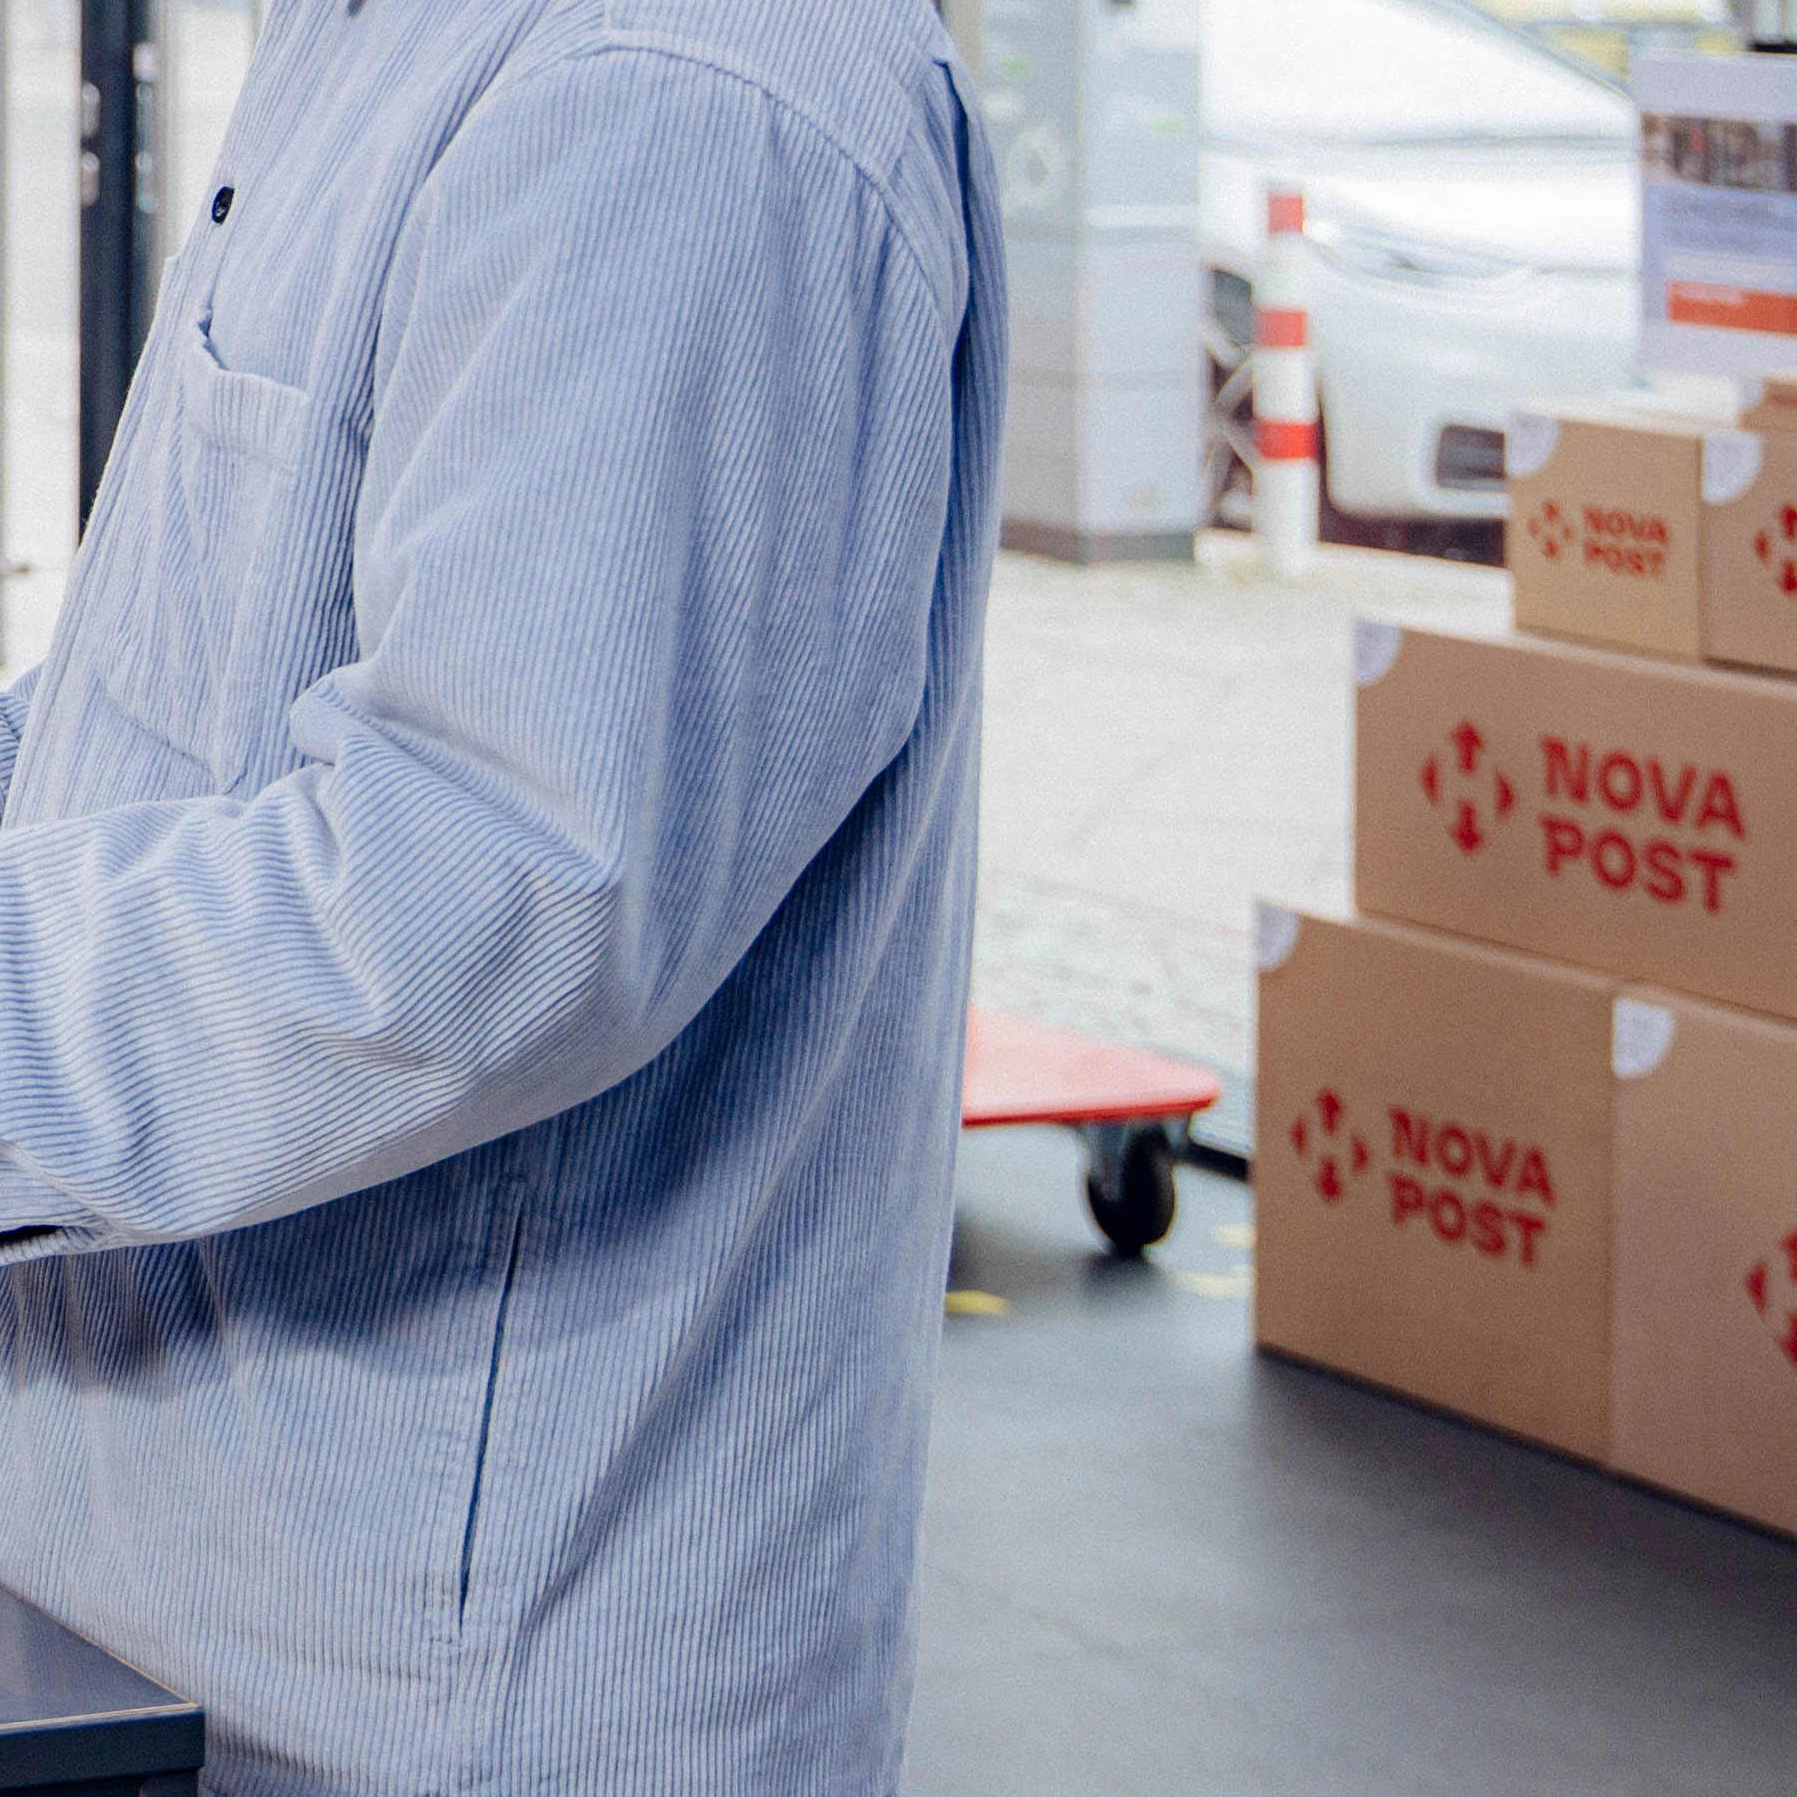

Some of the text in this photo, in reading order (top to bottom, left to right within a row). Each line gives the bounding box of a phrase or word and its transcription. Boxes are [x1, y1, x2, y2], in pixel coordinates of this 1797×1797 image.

[1582, 504, 1668, 542] NOVA
[1583, 540, 1667, 579] POST
[1541, 736, 1745, 838] NOVA
[1542, 816, 1735, 912] POST
[1389, 1105, 1556, 1207] NOVA
[1389, 1176, 1546, 1267] POST
